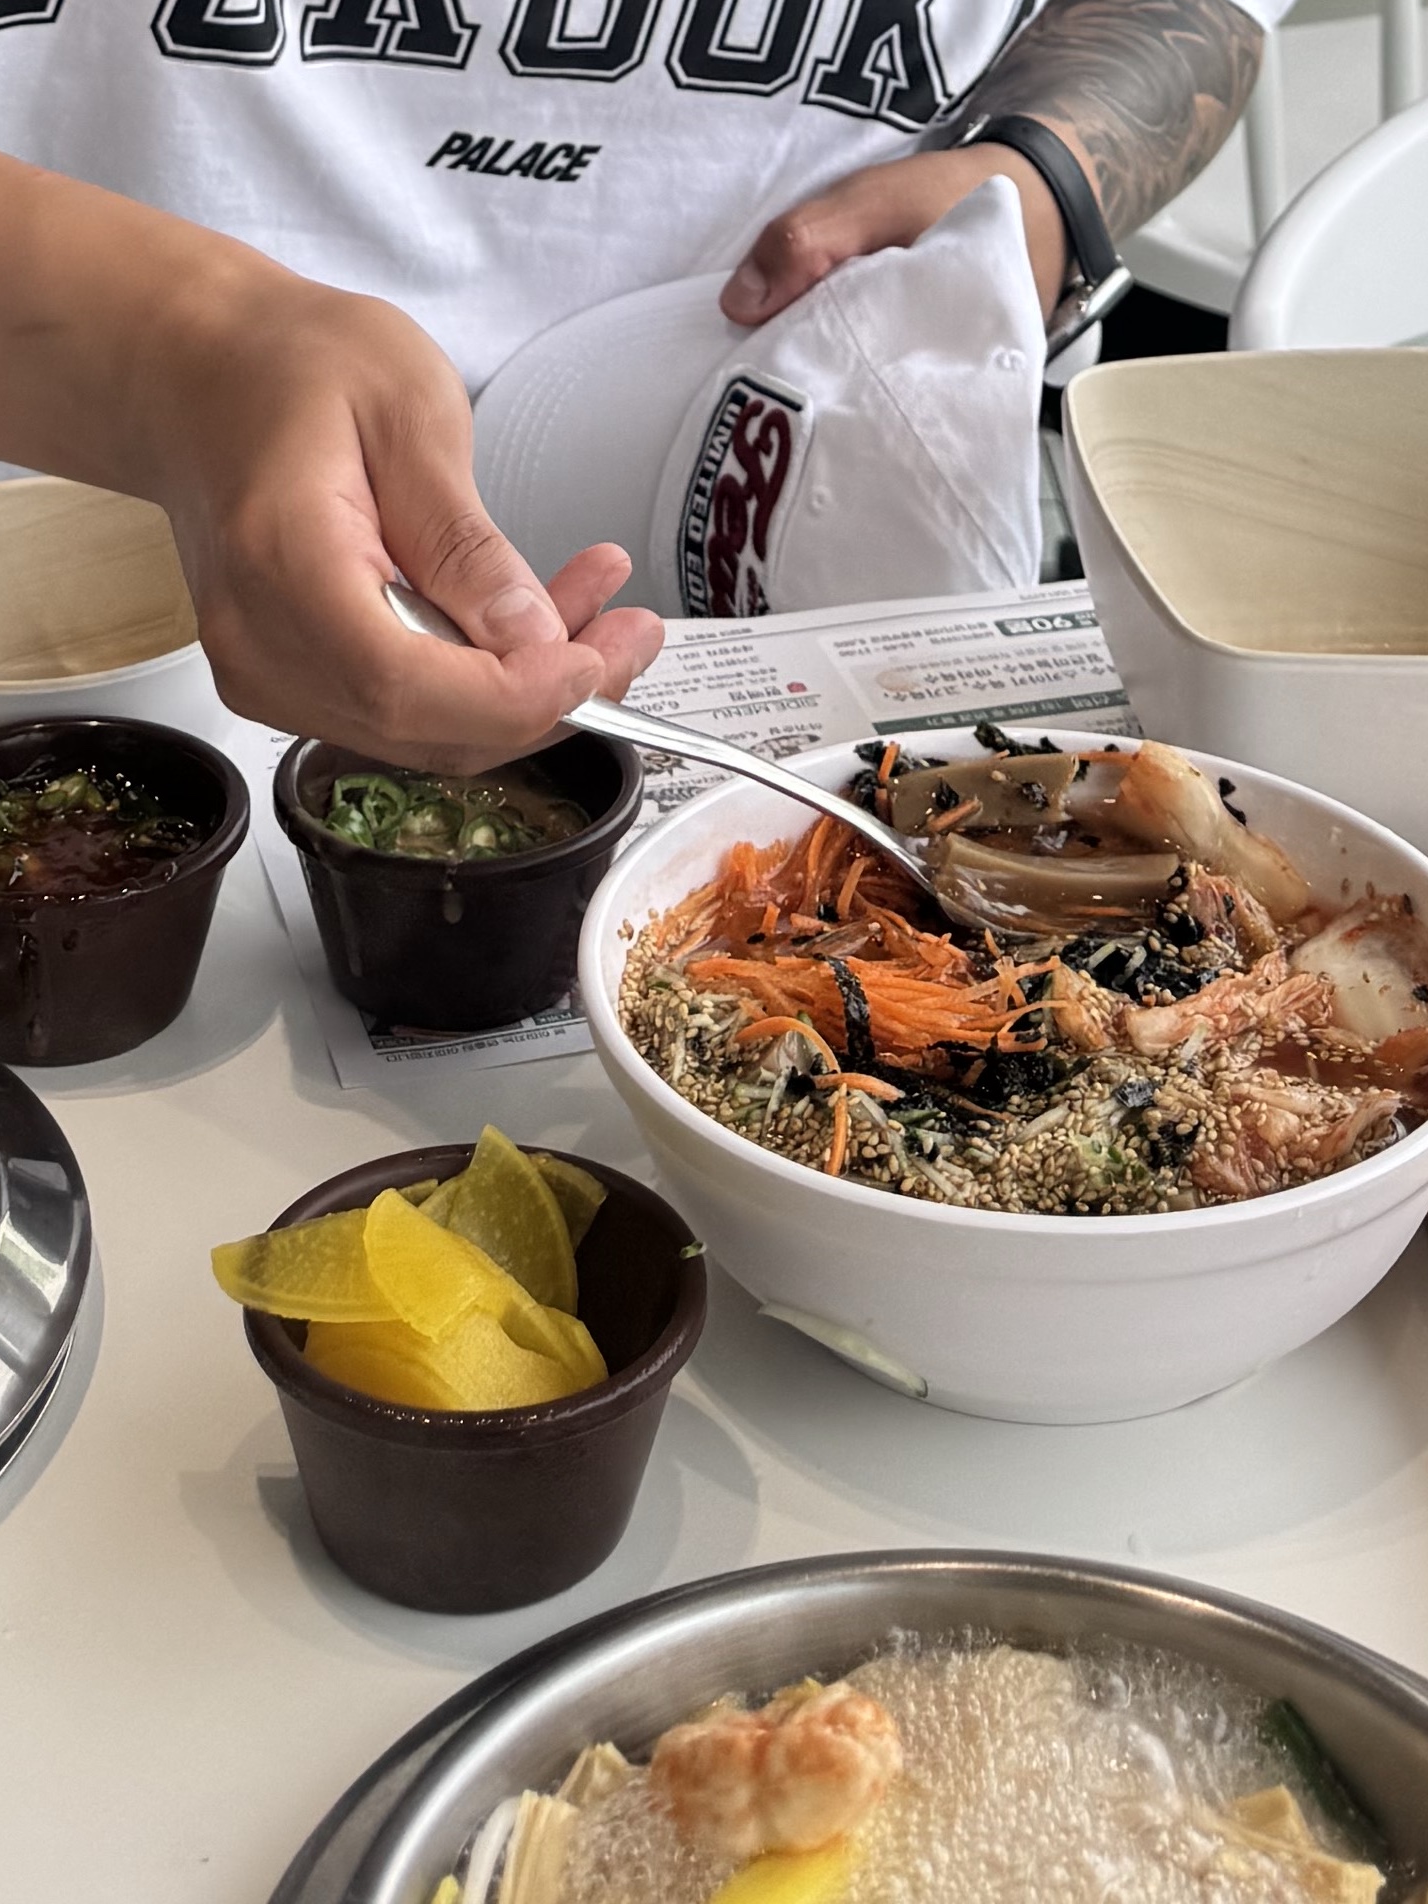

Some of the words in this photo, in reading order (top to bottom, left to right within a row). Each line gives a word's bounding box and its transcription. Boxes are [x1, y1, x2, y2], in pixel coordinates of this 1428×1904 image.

[425, 131, 600, 183] PALACE
[775, 696, 818, 711] SIDE
[713, 704, 770, 720] MENU
